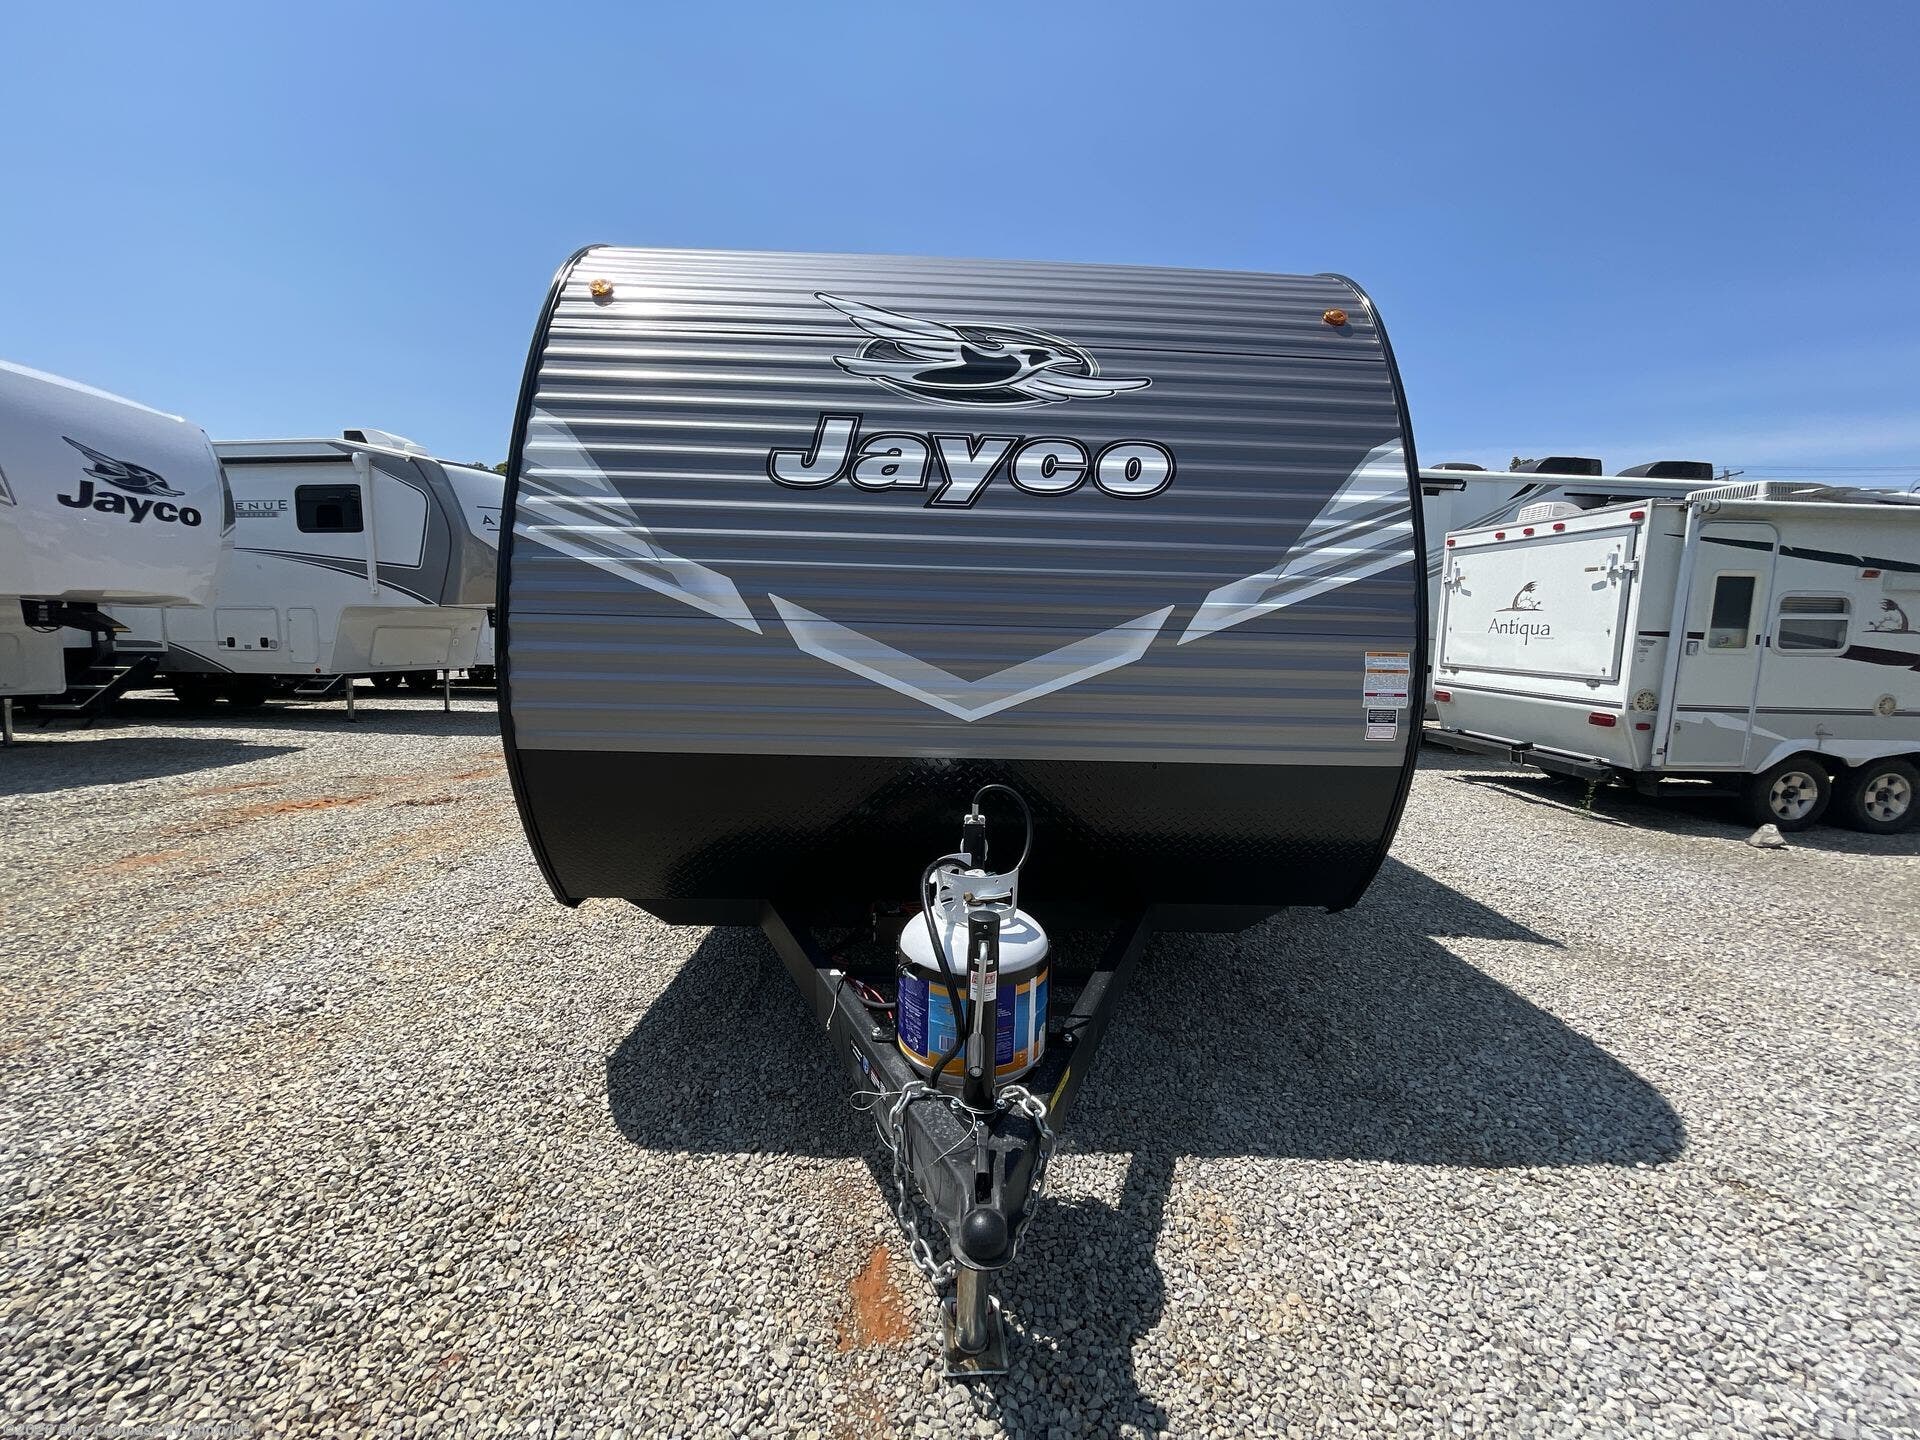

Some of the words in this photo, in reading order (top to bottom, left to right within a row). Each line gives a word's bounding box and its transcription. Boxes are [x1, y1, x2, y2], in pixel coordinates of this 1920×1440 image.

[766, 411, 1177, 509] Jayco
[57, 480, 202, 527] Jayco
[235, 499, 288, 511] ENUE
[1487, 617, 1551, 646] Antiqua
